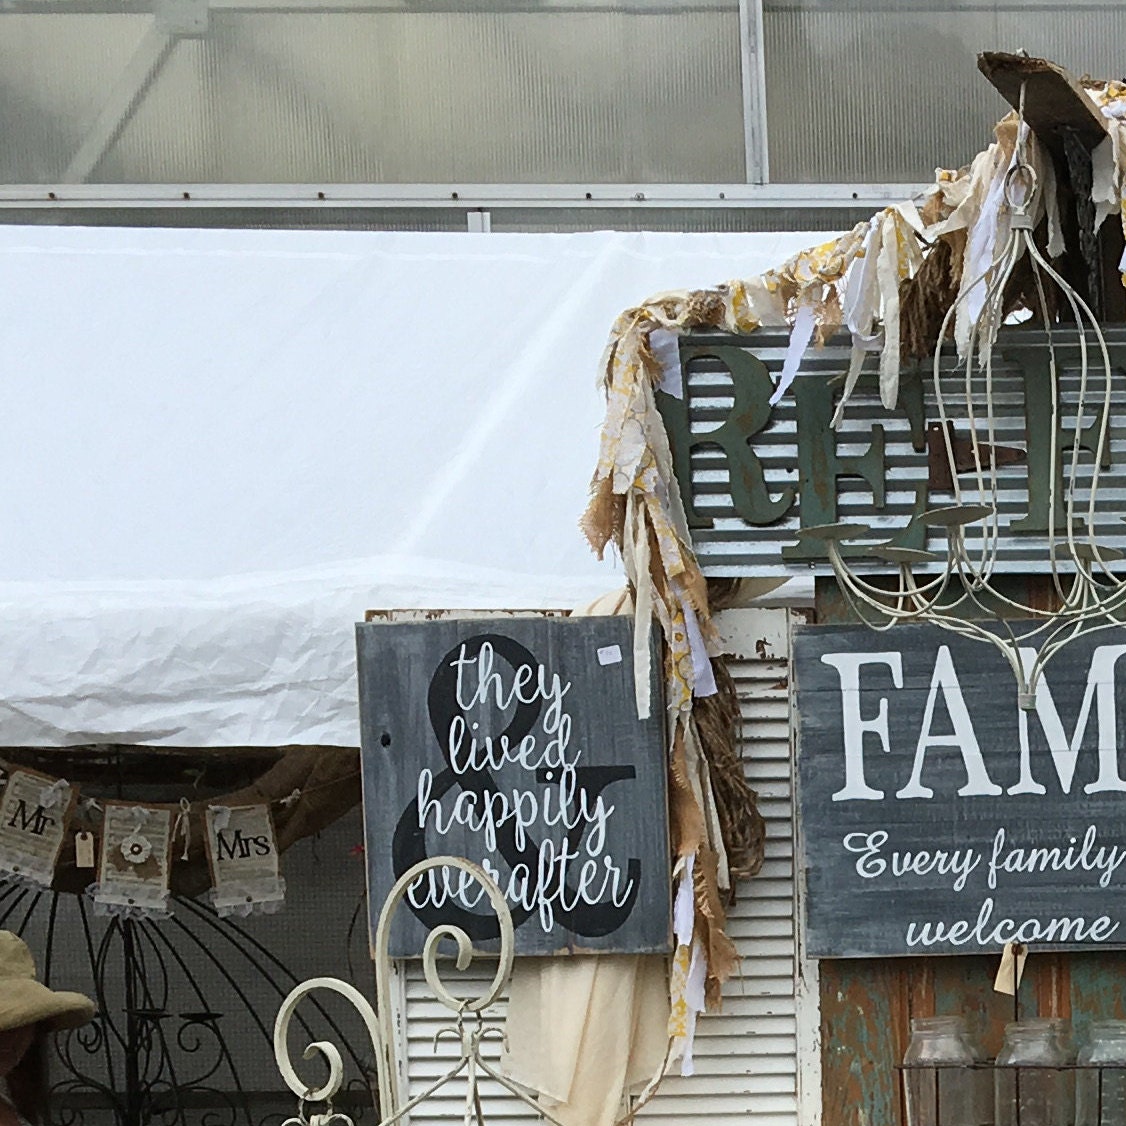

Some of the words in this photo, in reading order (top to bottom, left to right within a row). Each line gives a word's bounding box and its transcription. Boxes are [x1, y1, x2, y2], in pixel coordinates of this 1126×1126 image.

[450, 641, 572, 734] they
[449, 713, 581, 774] lived
[8, 799, 55, 835] Mr
[417, 763, 615, 856] happily
[216, 829, 271, 861] Mrs
[842, 830, 981, 892] Every
[906, 898, 1120, 946] welcome
